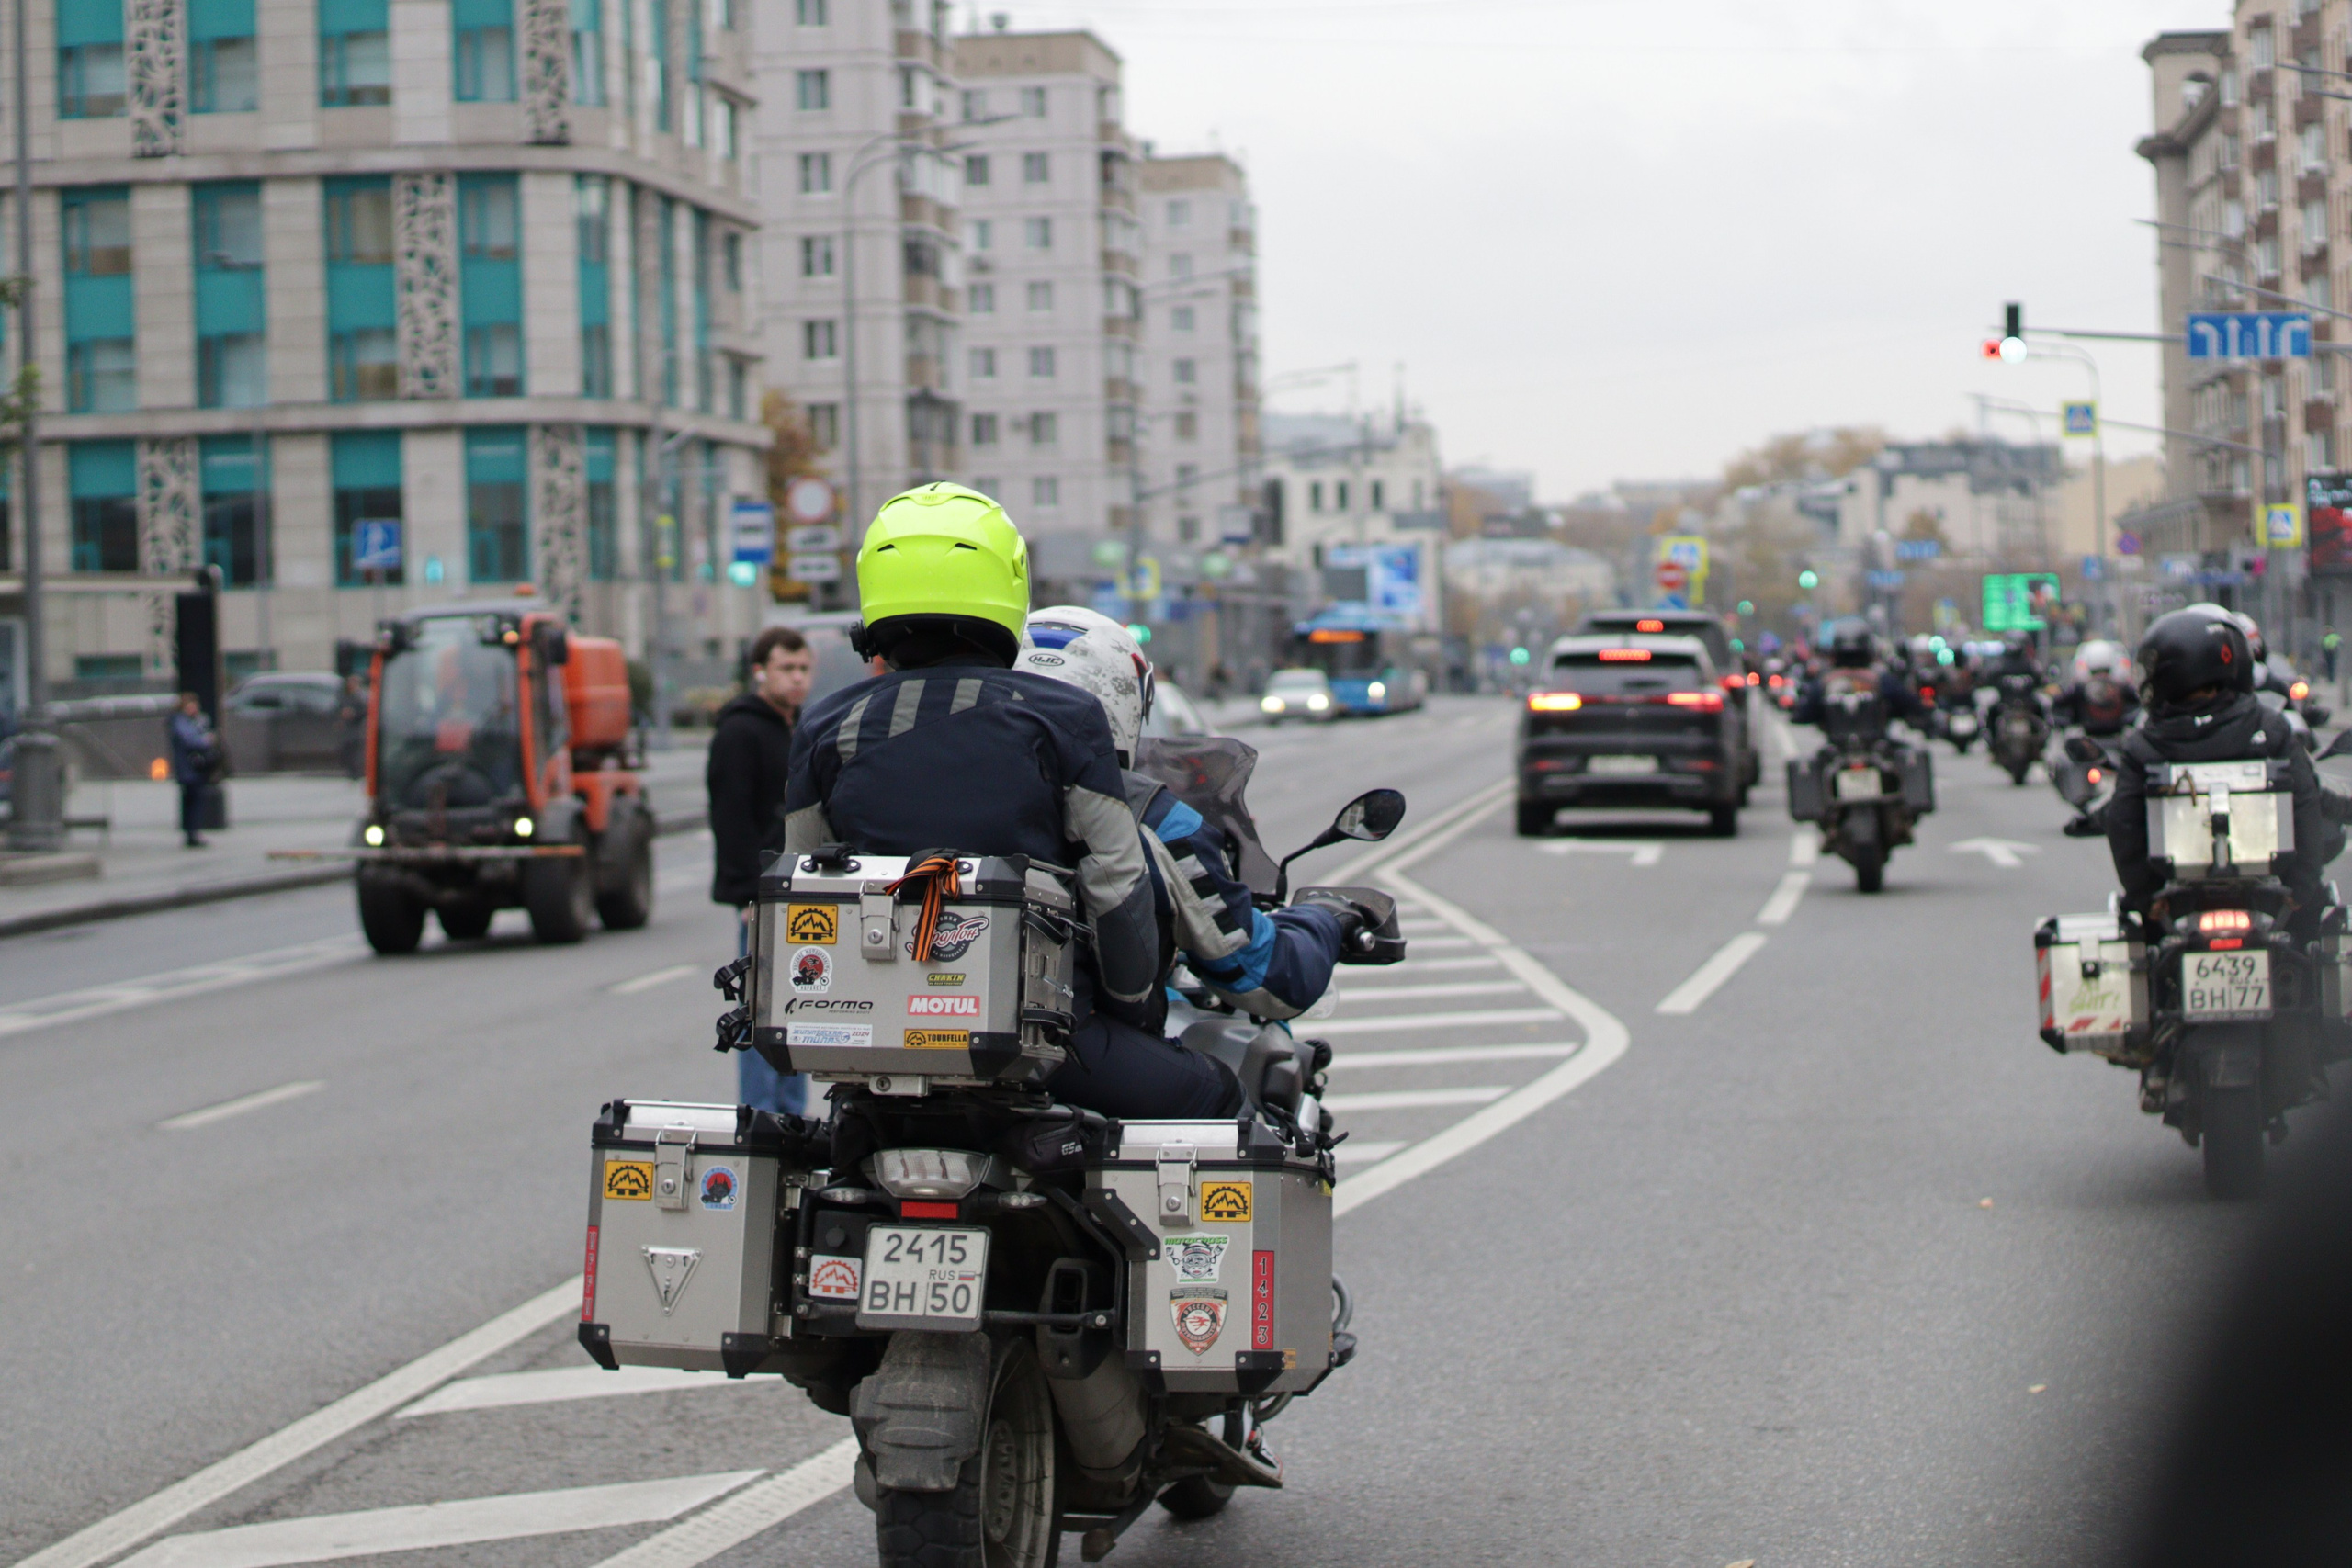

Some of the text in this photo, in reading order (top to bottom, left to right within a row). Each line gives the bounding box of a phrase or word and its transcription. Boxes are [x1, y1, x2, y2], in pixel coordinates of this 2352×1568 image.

[1033, 655, 1061, 665] HJC
[2197, 956, 2256, 978] 6439
[928, 974, 965, 982] CHAKIN
[2234, 985, 2264, 1007] 77
[909, 997, 978, 1014] MOTUL
[927, 1034, 967, 1043] TOURFELLA
[1061, 1141, 1076, 1156] GS
[883, 1233, 967, 1264] 2415
[929, 1269, 956, 1280] RUS
[929, 1282, 971, 1313] 50
